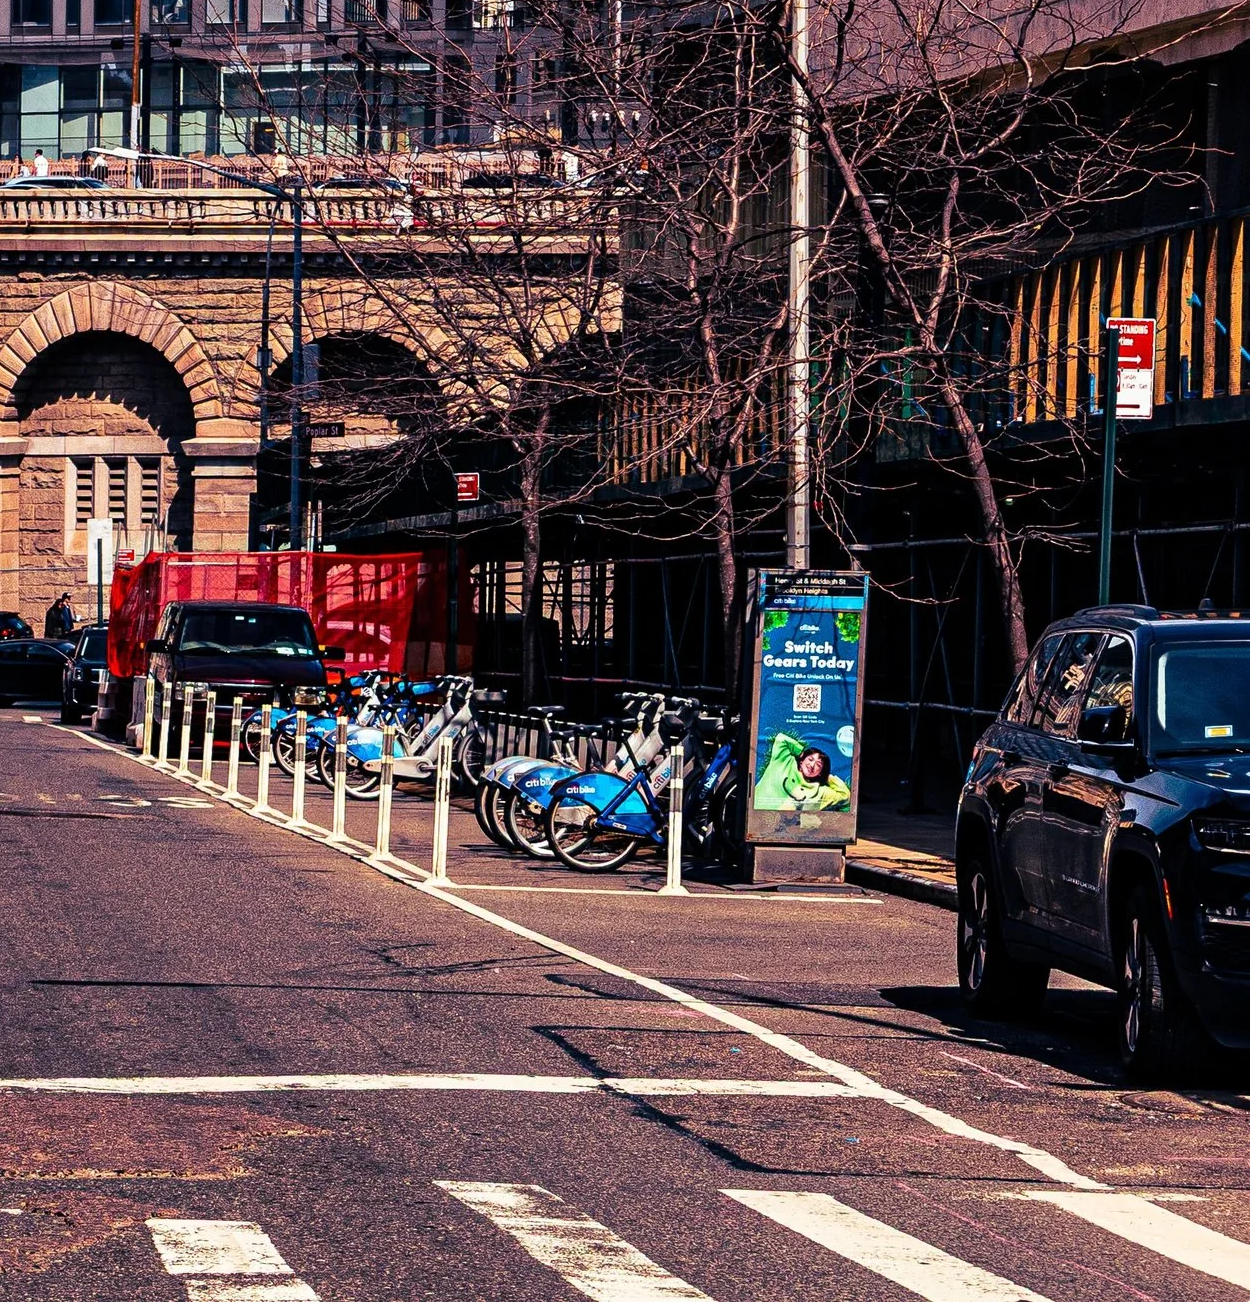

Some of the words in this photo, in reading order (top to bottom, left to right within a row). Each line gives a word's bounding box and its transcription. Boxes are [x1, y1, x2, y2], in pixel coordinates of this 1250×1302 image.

[305, 426, 328, 437] Poplar
[331, 426, 339, 436] St
[775, 577, 793, 585] Hen
[784, 640, 834, 654] Switch
[763, 654, 808, 668] Gears
[809, 655, 855, 672] Today
[525, 778, 540, 788] citi
[566, 783, 579, 794] citi
[579, 785, 596, 794] bike
